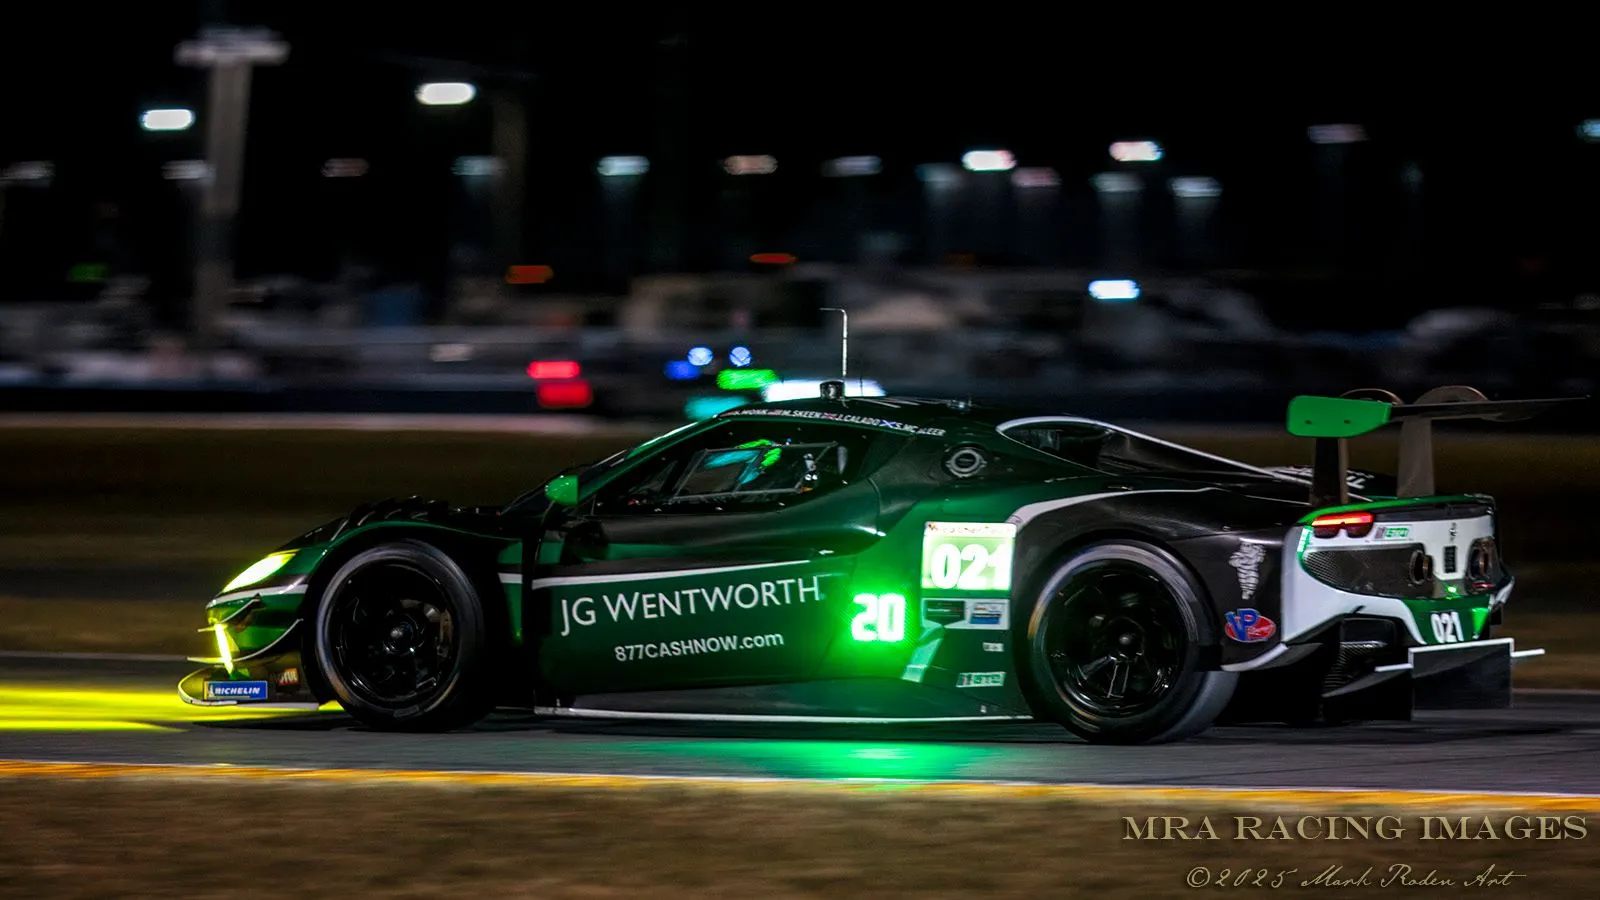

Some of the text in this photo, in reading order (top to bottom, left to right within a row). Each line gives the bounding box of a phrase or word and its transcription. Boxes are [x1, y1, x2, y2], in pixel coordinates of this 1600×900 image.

[930, 543, 1012, 590] 021
[560, 577, 820, 637] JG WENTWORTH
[851, 592, 906, 642] 20
[1431, 611, 1464, 643] 021
[614, 633, 784, 662] 877CASHNOW.com
[214, 686, 261, 695] MICHELIN
